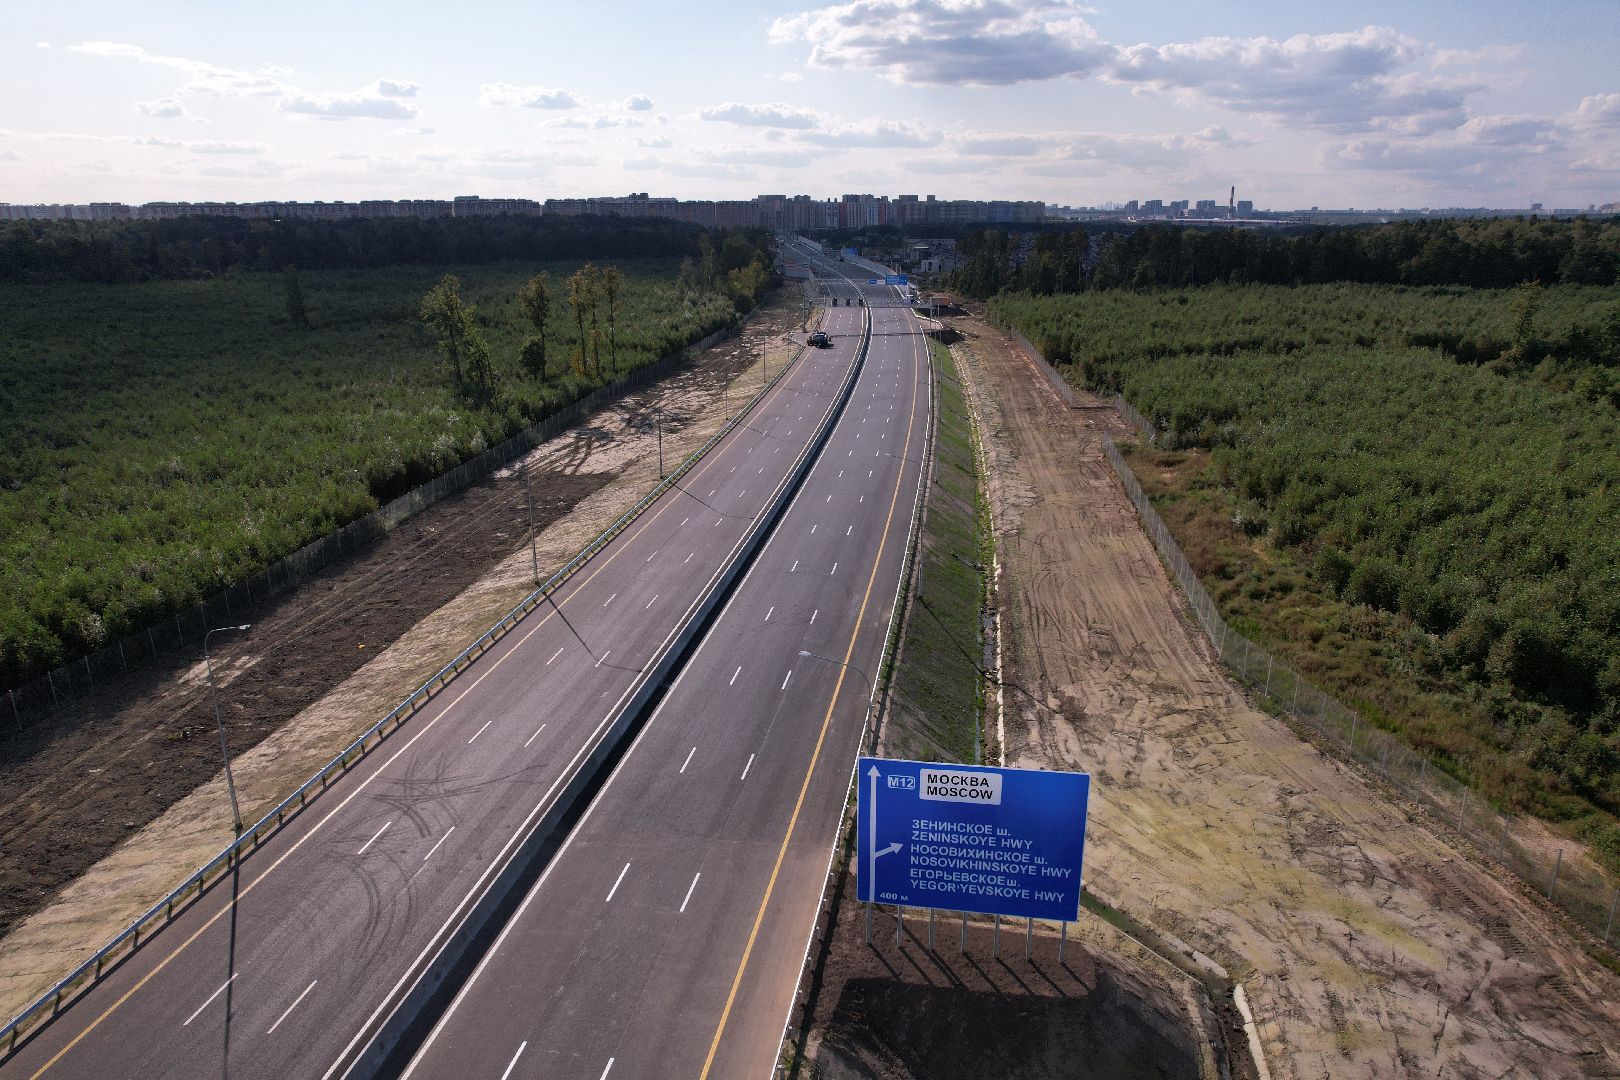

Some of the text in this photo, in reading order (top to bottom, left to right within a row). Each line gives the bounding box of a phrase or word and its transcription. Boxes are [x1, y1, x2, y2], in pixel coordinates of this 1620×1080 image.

[927, 774, 989, 787] МОСКВА
[927, 786, 993, 799] MOSCOW
[912, 820, 1010, 836] ЗЕНИНСКОЕ ш.
[912, 831, 1032, 850] ZENINSKOYE HWY
[911, 844, 1048, 864] НОСОВИХИНСКОЕ ш.
[910, 856, 1072, 878] NOSOVIKHINSKOYE HWY
[910, 869, 1005, 886] ЕГОРЬЕВСКОЕ
[880, 892, 897, 901] 400
[1034, 891, 1064, 902] HWY
